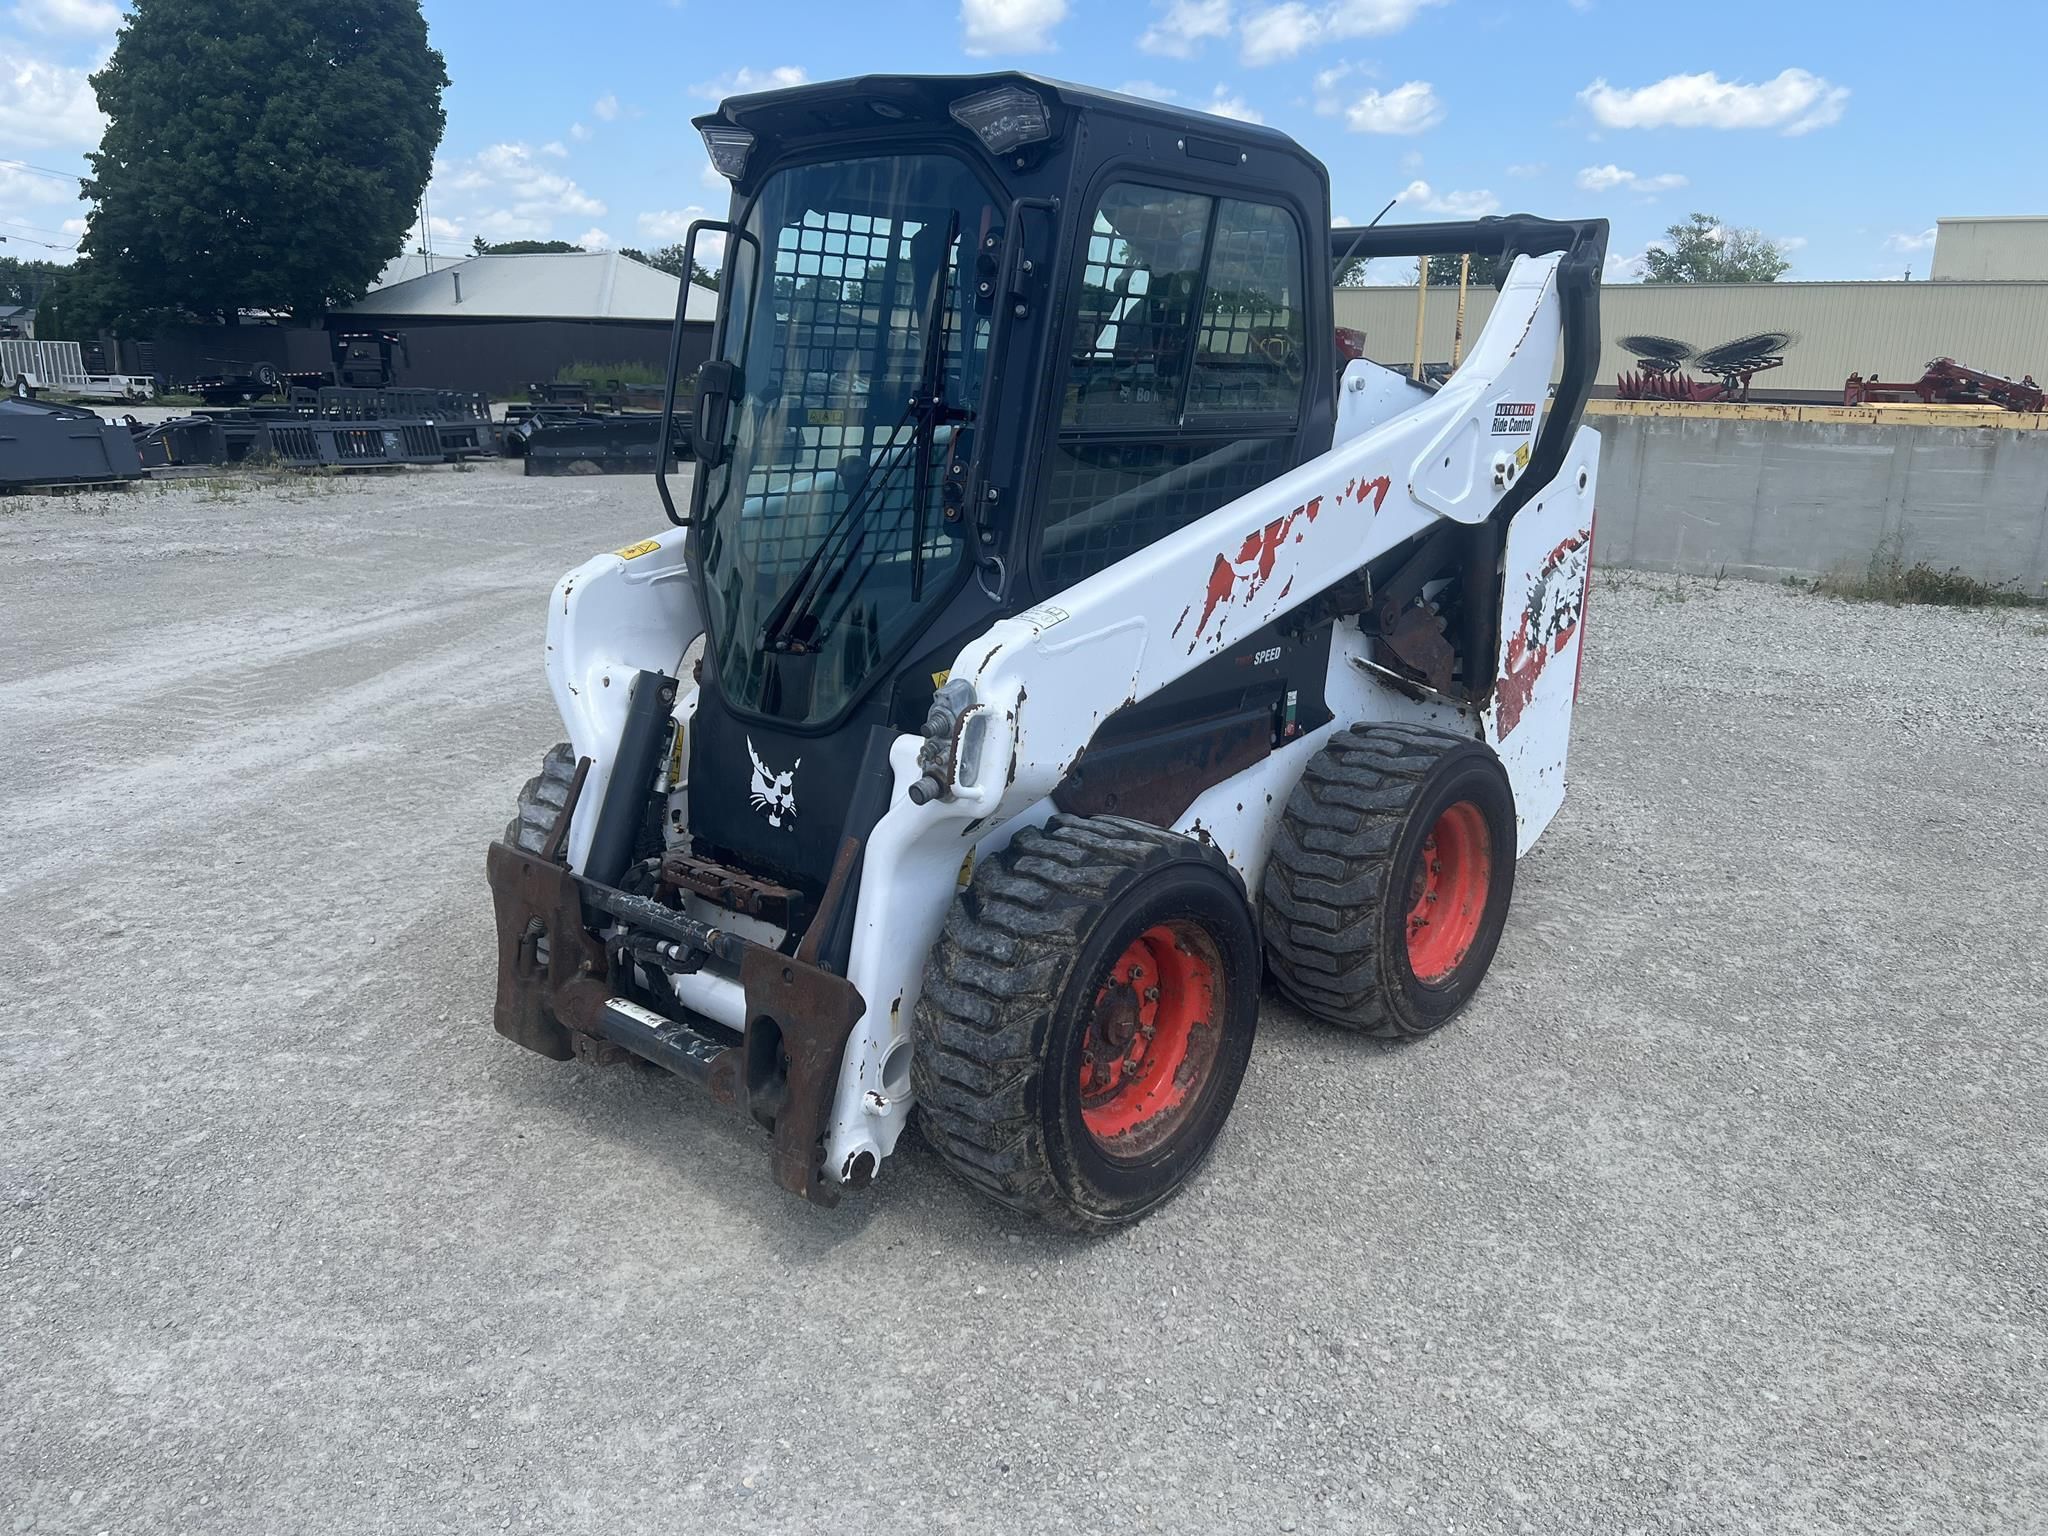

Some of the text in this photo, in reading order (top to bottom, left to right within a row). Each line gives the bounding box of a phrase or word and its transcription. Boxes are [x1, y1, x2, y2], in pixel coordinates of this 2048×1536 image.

[1496, 405, 1535, 415] AUTOMATIC
[1491, 418, 1533, 432] Ride Control
[1254, 646, 1281, 665] SPEED
